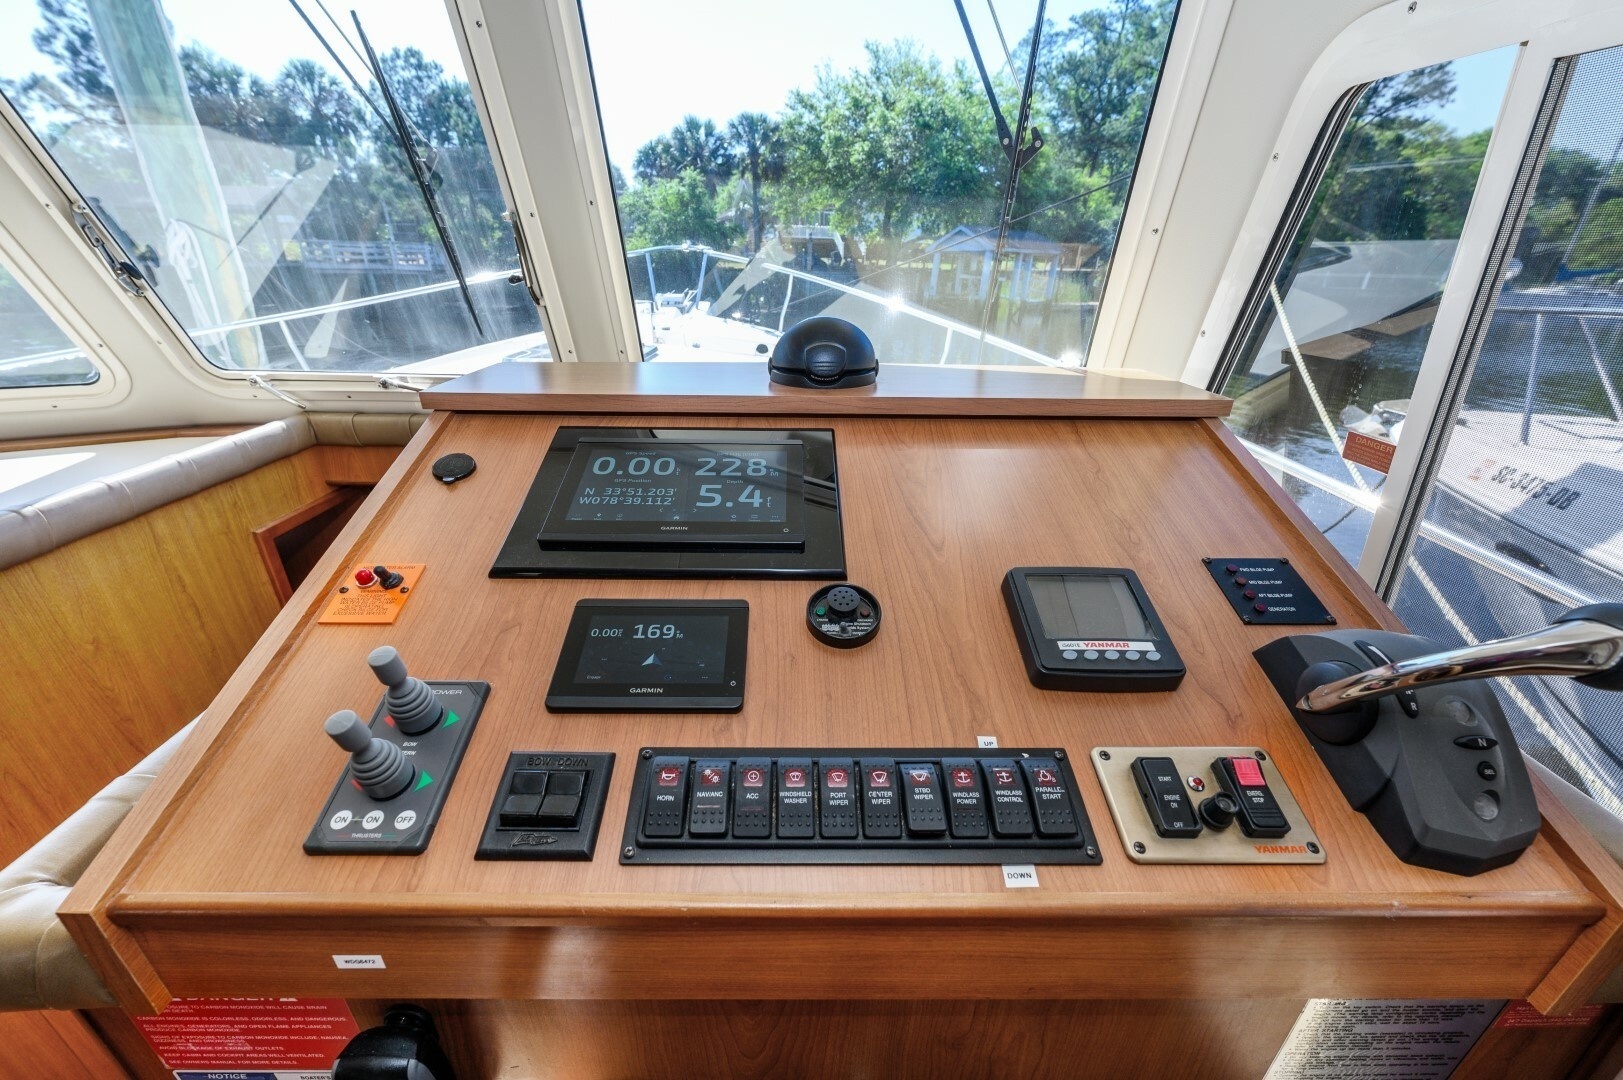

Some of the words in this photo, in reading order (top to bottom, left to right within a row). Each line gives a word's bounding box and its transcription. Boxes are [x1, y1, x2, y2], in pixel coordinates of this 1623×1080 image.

[1355, 436, 1393, 453] DANGER
[592, 457, 676, 476] 0.00
[694, 457, 767, 477] 228
[584, 487, 595, 496] N
[695, 484, 764, 508] 5.4
[590, 628, 619, 637] 0.00
[632, 624, 675, 639] 169
[1478, 738, 1488, 747] N
[527, 757, 550, 767] BOW
[556, 757, 590, 767] DOWN
[994, 789, 1023, 797] WINDLASS
[334, 816, 349, 824] ON
[366, 816, 380, 824] ON
[396, 816, 415, 824] OFF
[1252, 845, 1308, 854] YANMAR
[1006, 872, 1032, 880] DOWN
